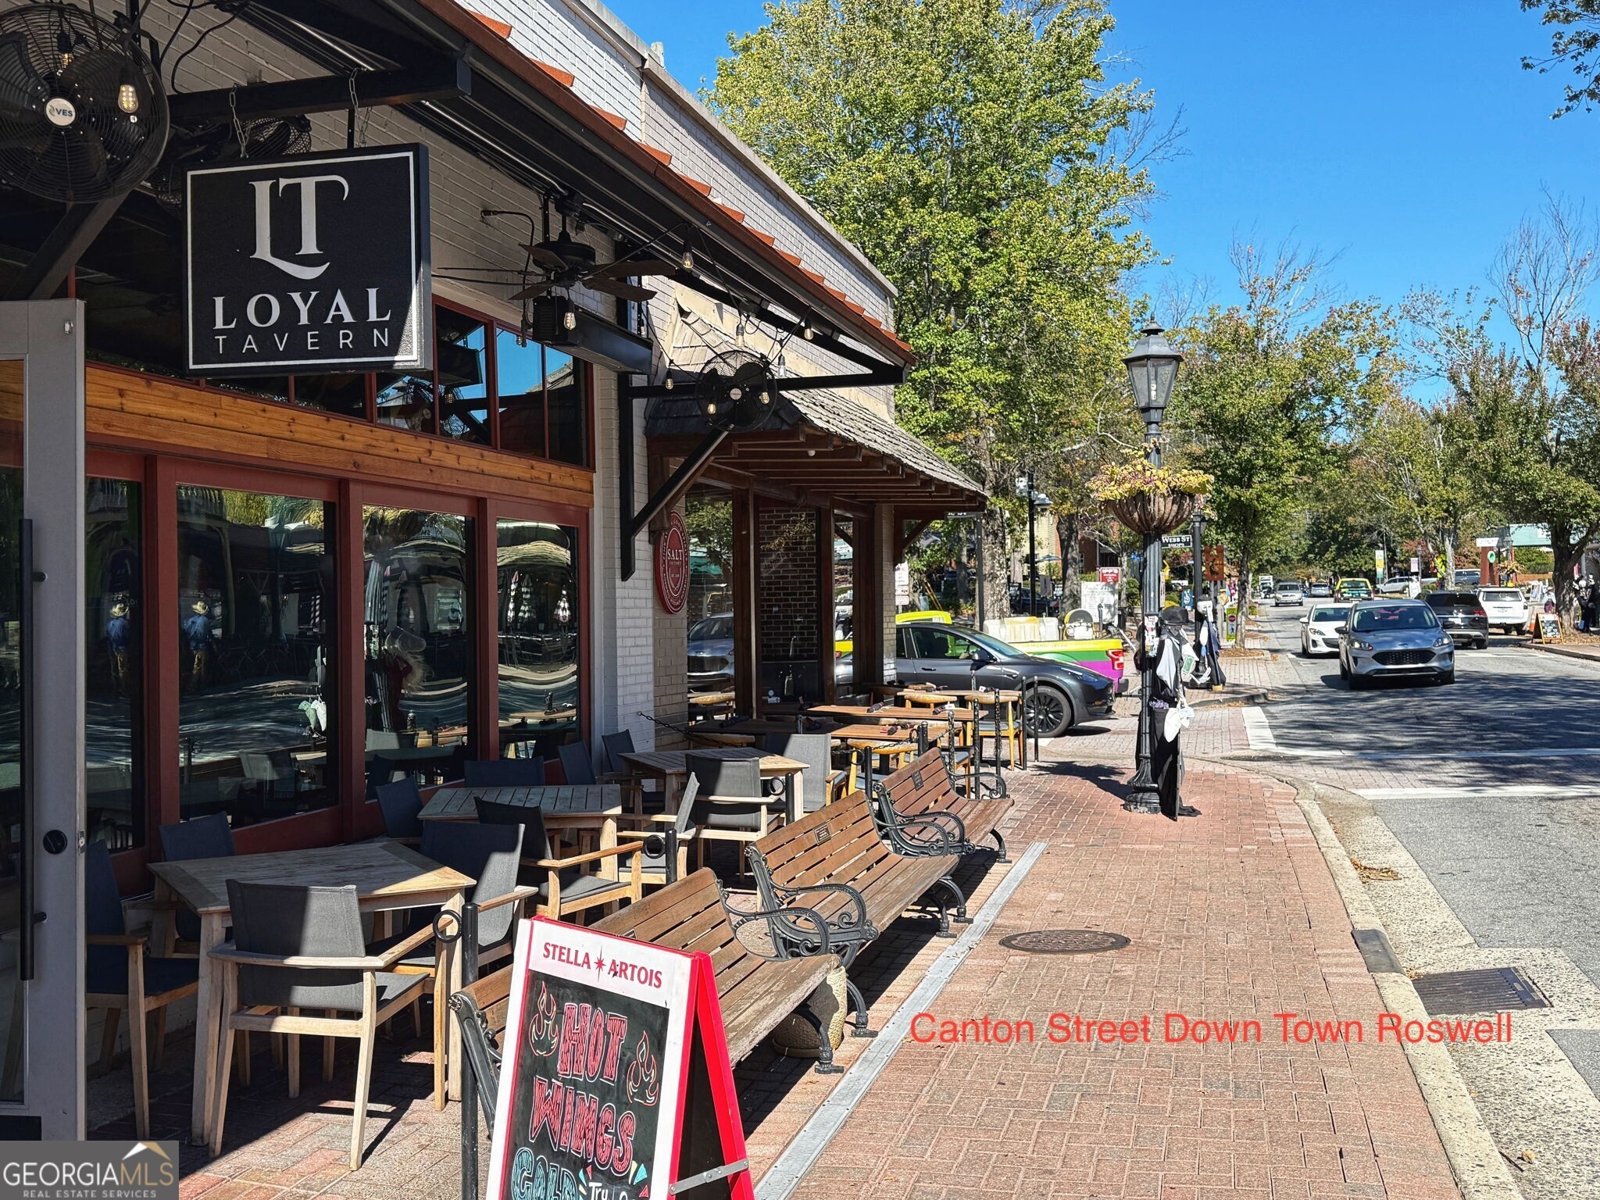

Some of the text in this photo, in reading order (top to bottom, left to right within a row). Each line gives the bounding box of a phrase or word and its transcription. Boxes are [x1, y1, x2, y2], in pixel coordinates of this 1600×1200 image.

[249, 175, 349, 280] LT
[212, 287, 392, 330] LOYAL
[214, 327, 389, 354] TAVERN
[667, 549, 684, 560] SALT
[543, 942, 663, 988] STELLA ARTOIS
[558, 1002, 628, 1086] HOT
[529, 1075, 636, 1177] WINGS
